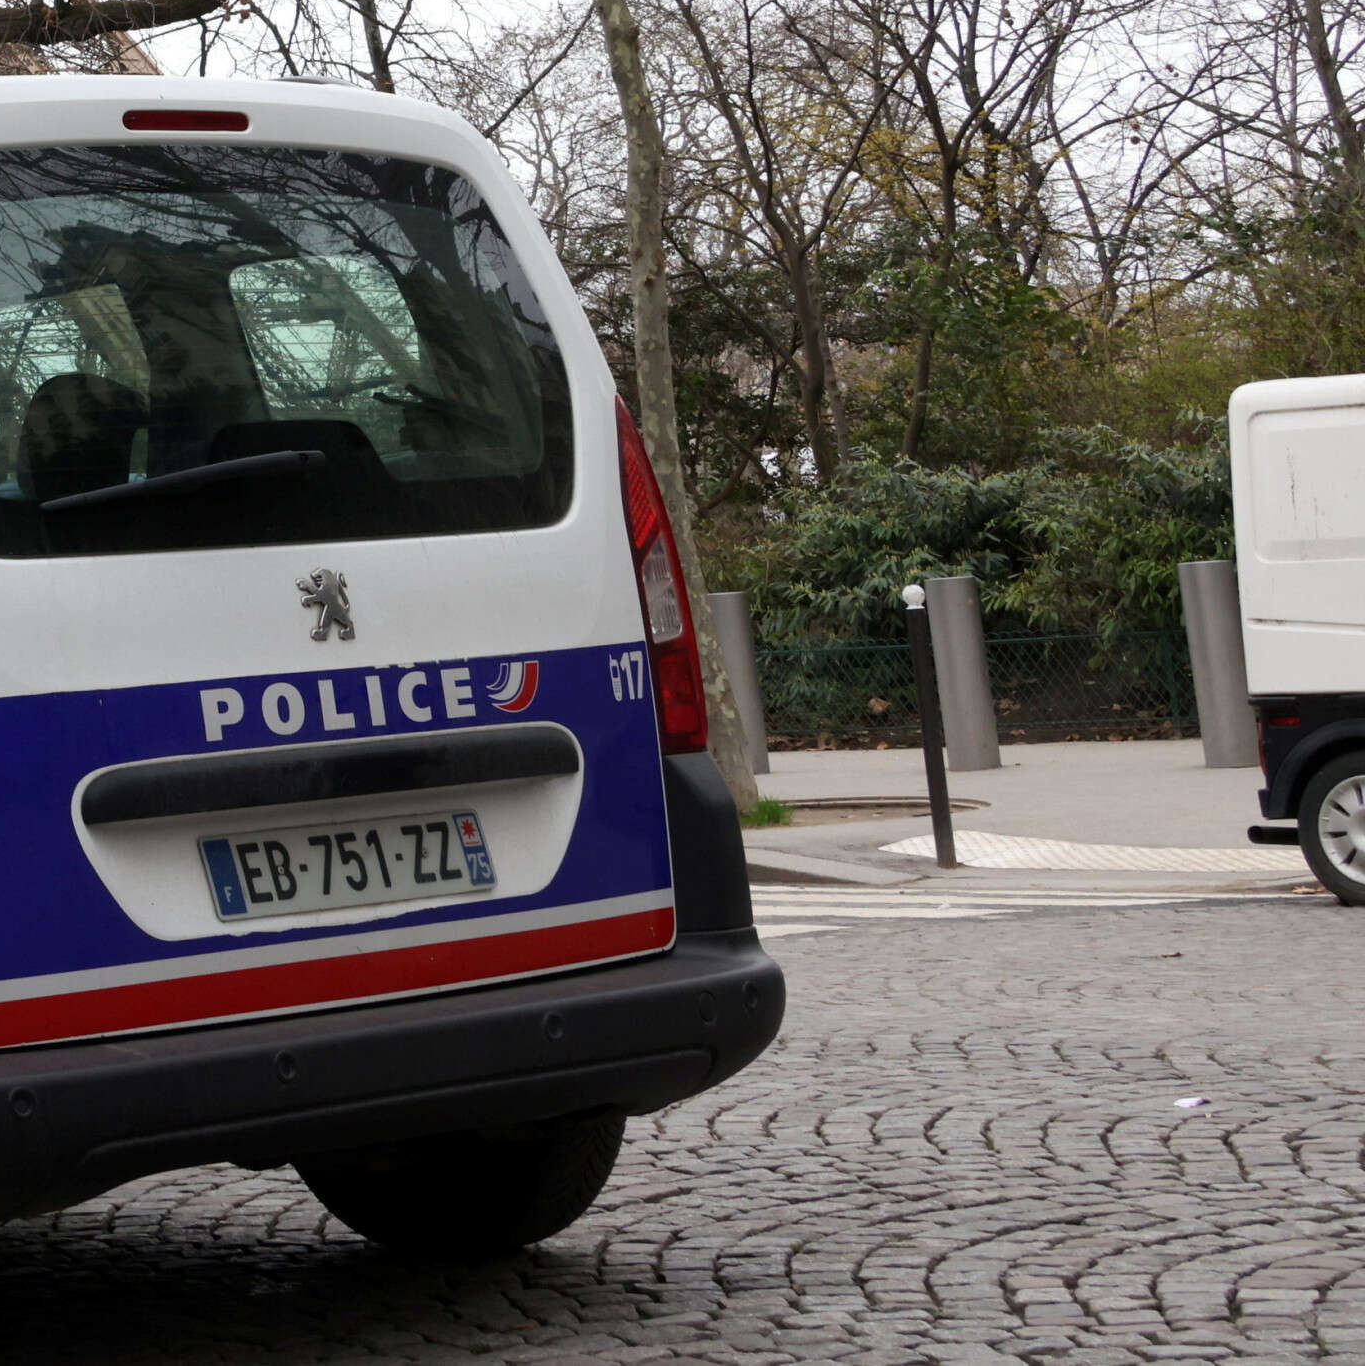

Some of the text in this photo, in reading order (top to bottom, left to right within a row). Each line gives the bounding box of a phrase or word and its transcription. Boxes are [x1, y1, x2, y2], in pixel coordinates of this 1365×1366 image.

[200, 667, 476, 742] POLICE
[620, 650, 644, 701] 17
[236, 821, 463, 903] EB-751-ZZ
[468, 851, 492, 880] 75
